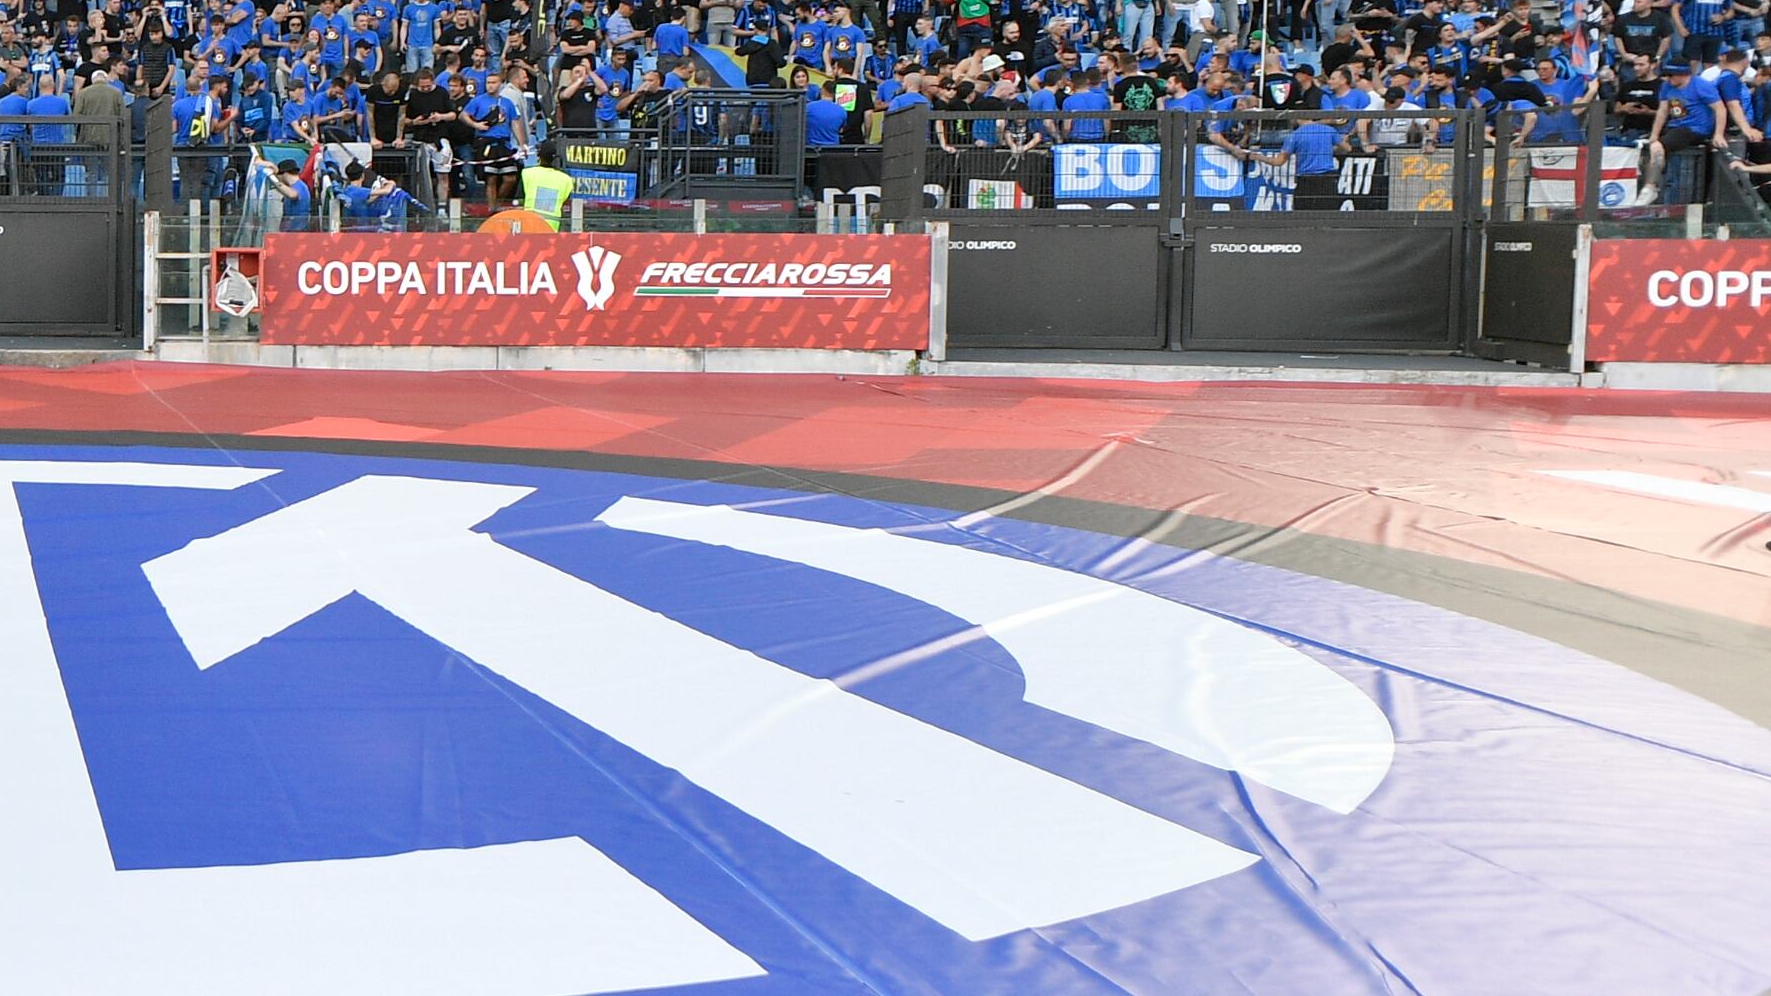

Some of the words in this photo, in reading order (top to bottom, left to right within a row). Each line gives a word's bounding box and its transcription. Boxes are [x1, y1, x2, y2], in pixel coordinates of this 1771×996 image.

[566, 145, 627, 167] MARTINO
[1060, 144, 1240, 192] BOS
[573, 177, 627, 198] ESENTE
[966, 240, 1016, 250] OLIMPICO
[1210, 243, 1248, 253] STADIO
[1249, 244, 1302, 254] OLIMPICO
[297, 260, 427, 296] COPPA
[437, 261, 558, 296] ITALIA
[639, 262, 892, 286] FRECCIAROSSA
